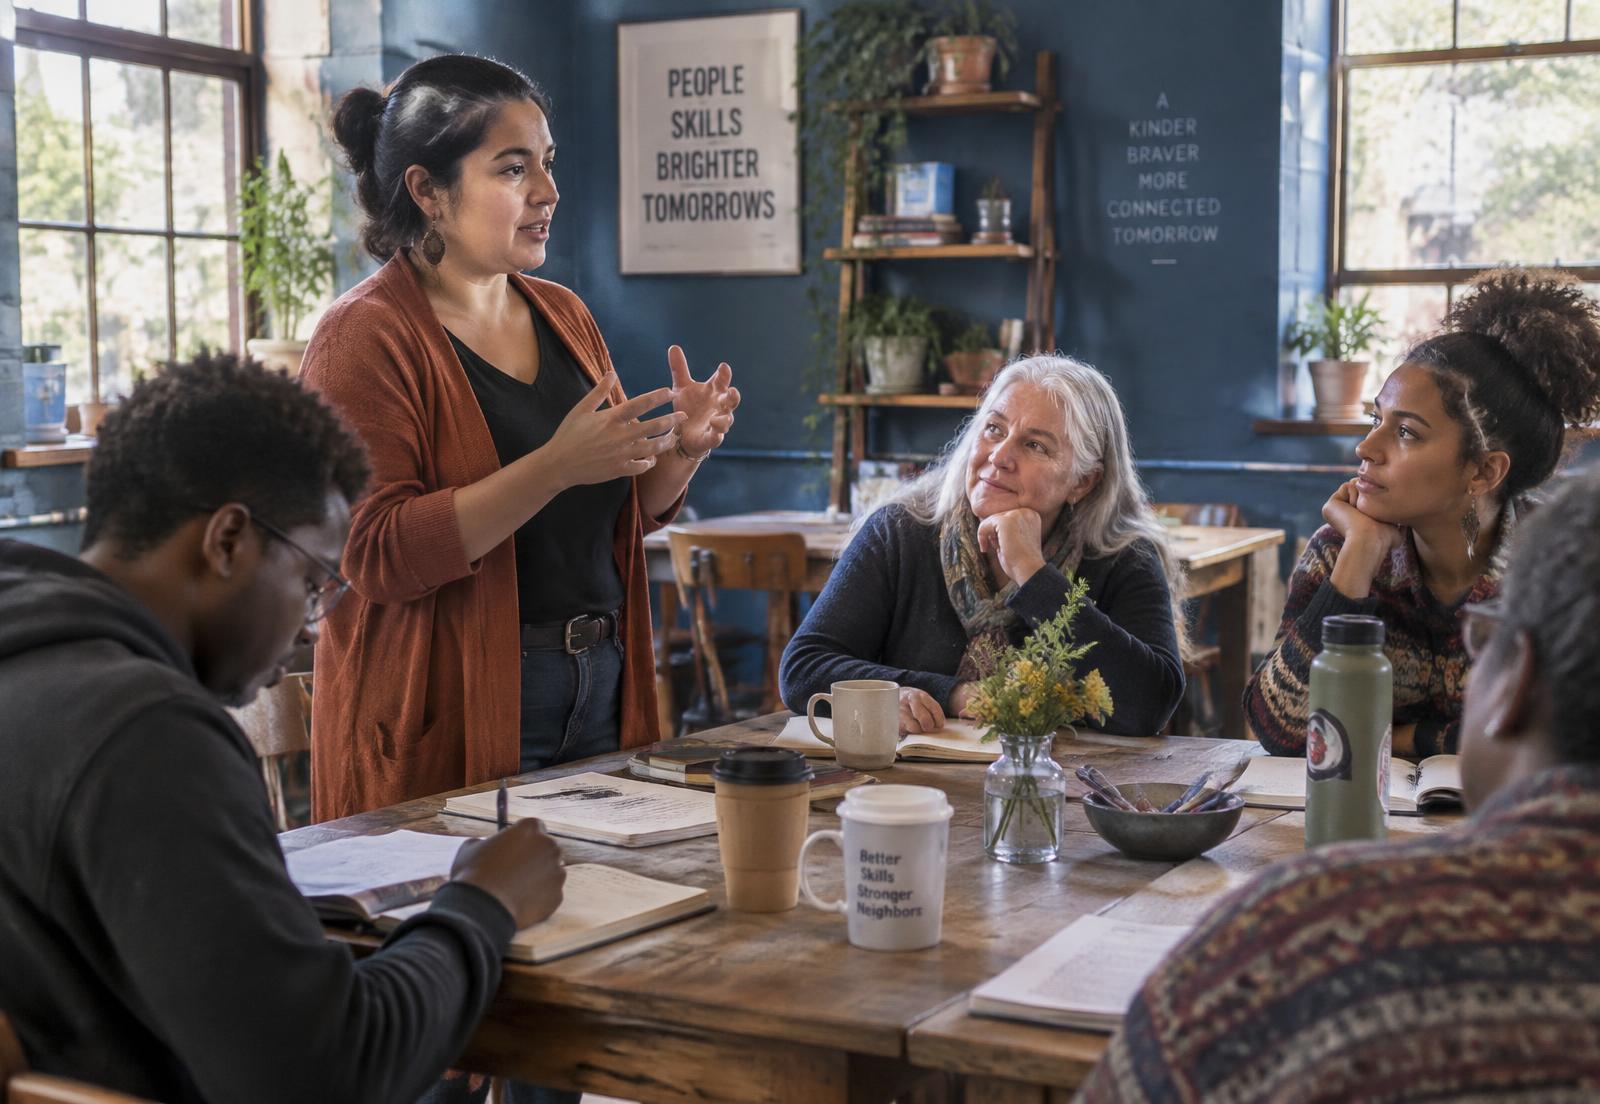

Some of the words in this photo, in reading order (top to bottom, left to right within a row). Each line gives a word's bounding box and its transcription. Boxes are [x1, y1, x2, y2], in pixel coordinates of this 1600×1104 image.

[668, 65, 744, 98] PEOPLE
[1156, 92, 1170, 109] A
[671, 107, 743, 140] SKILLS
[1129, 117, 1198, 137] KINDER
[1127, 143, 1200, 164] BRAVER
[656, 148, 759, 181] BRIGHTER
[1138, 171, 1189, 190] MORE
[642, 190, 776, 222] TOMORROWS
[1106, 197, 1222, 218] CONNECTED
[1112, 225, 1219, 245] TOMORROW
[860, 848, 902, 865] Better
[861, 867, 895, 883] Skills
[857, 884, 914, 904] Stronger
[857, 902, 923, 920] Neighbors
